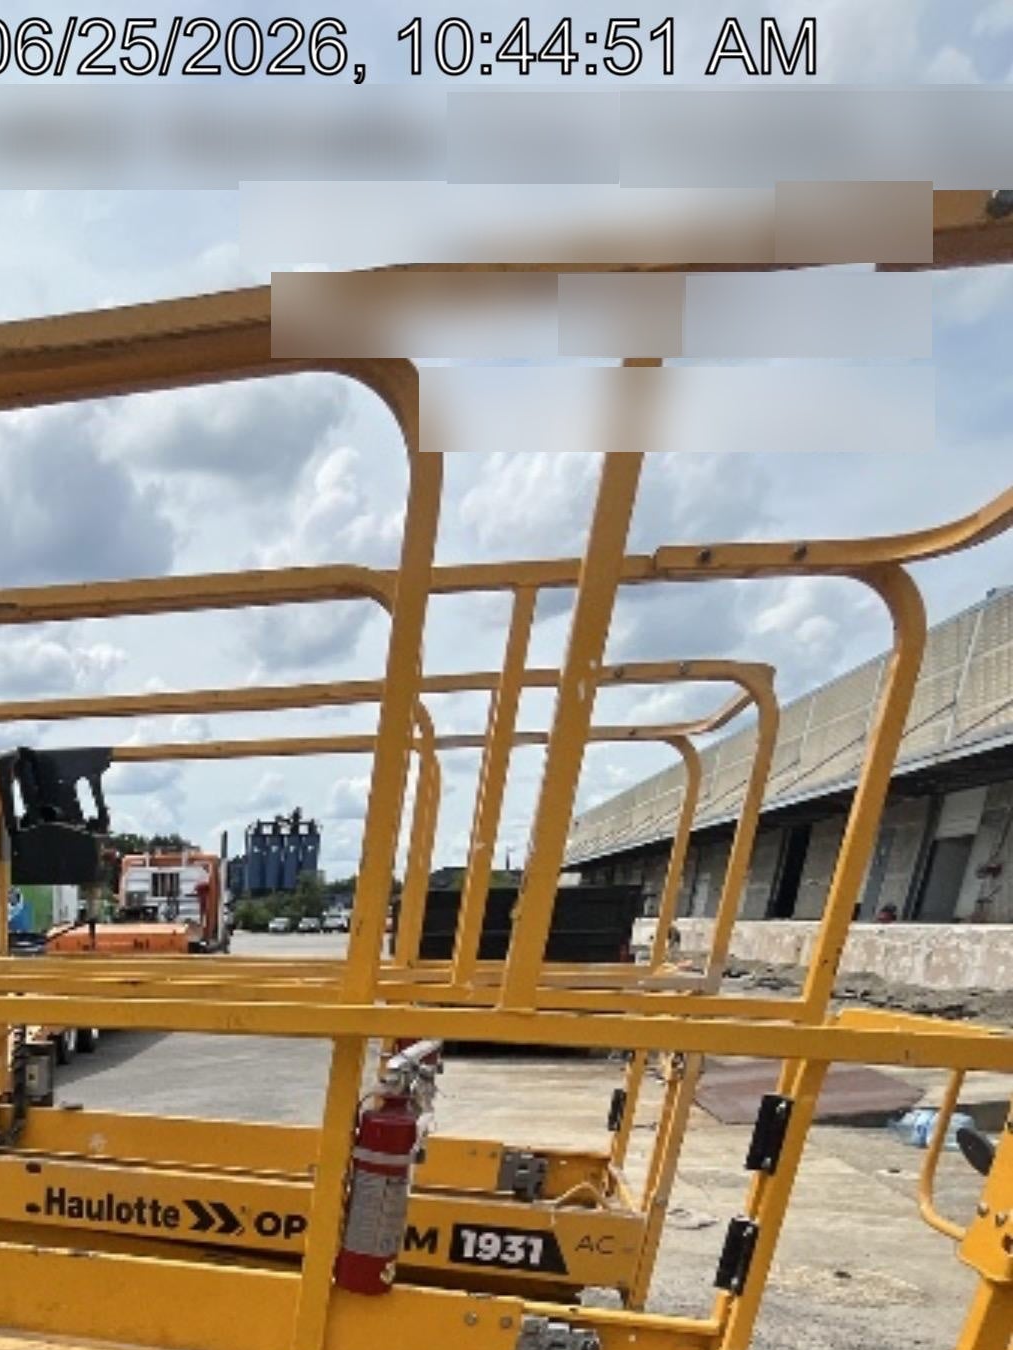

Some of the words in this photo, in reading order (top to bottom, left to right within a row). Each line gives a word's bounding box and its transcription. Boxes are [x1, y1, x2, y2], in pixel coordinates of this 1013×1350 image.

[45, 1186, 181, 1229] Haulotte
[460, 1228, 543, 1265] 1931
[574, 1233, 615, 1255] AC
